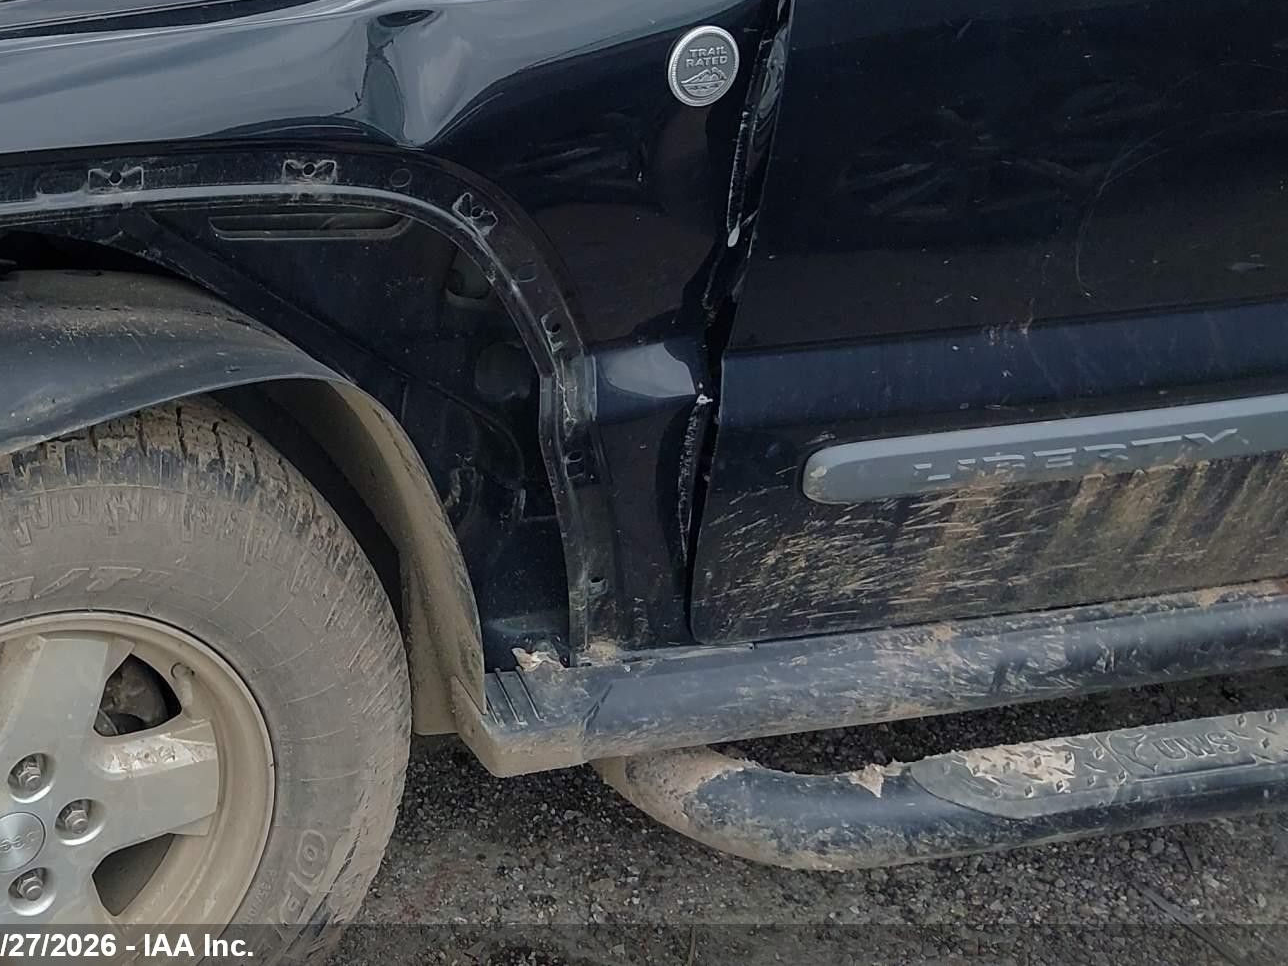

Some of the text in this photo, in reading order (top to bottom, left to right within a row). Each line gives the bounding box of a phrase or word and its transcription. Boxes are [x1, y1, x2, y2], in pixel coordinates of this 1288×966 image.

[689, 46, 728, 57] TRAIL
[686, 55, 728, 68] RATED
[1153, 732, 1240, 761] UWS
